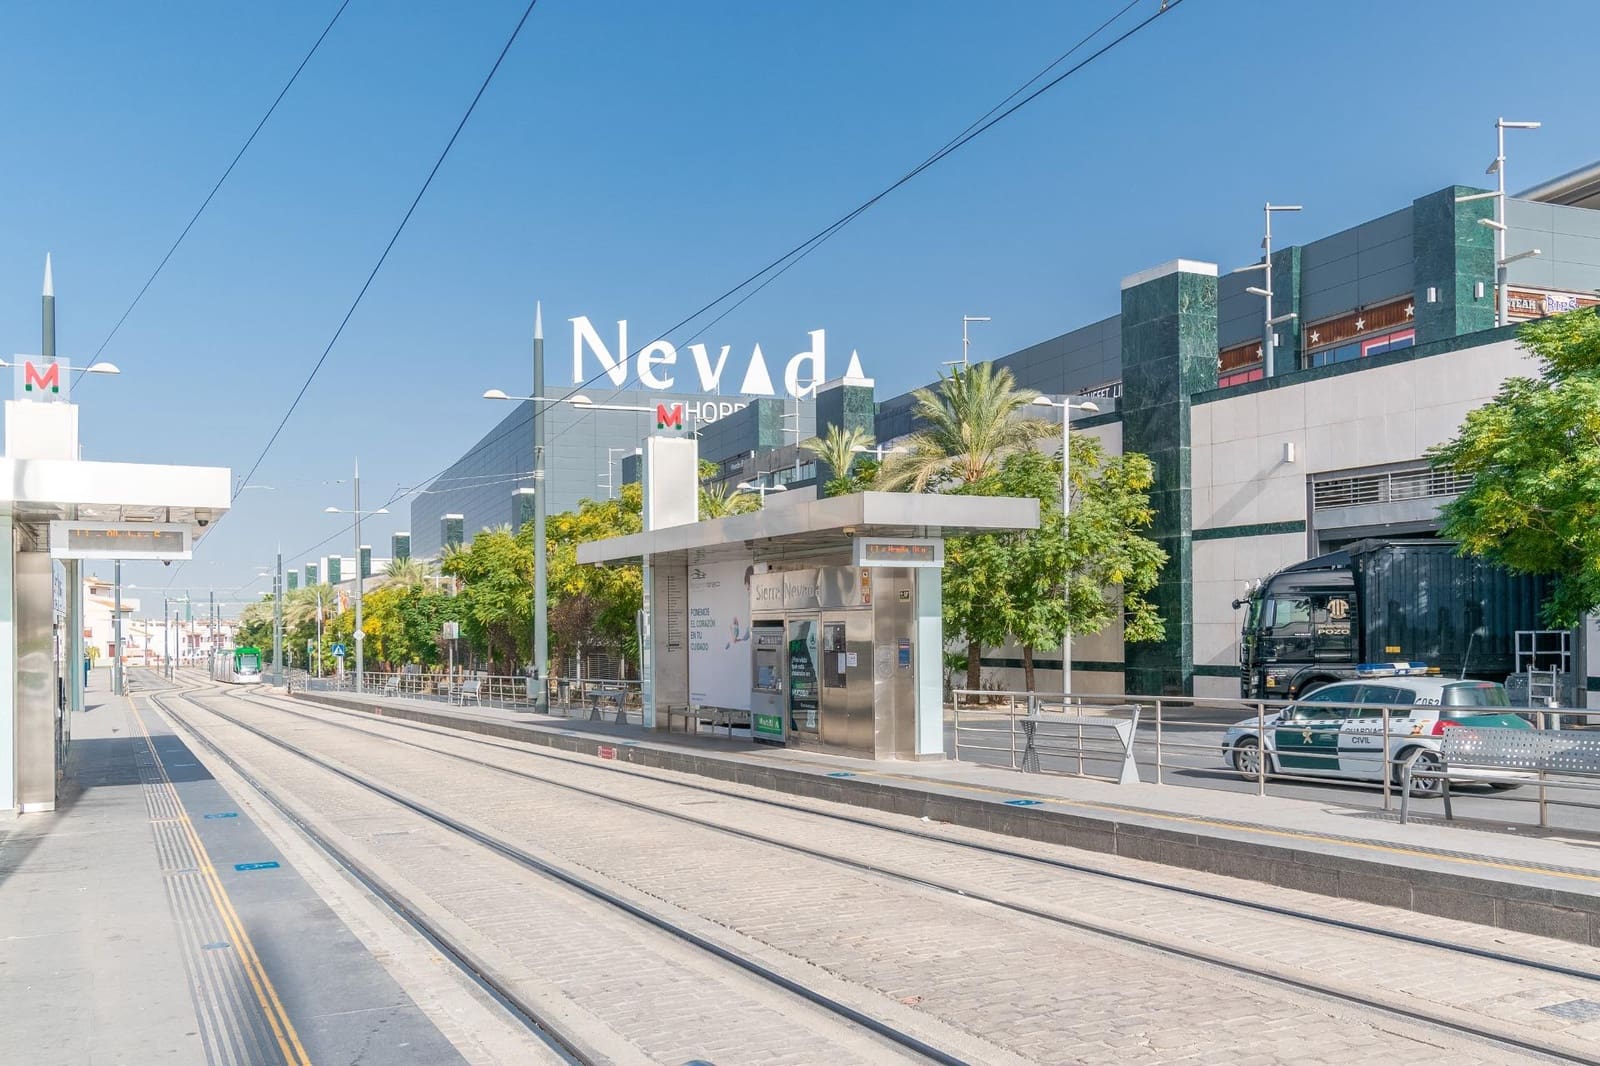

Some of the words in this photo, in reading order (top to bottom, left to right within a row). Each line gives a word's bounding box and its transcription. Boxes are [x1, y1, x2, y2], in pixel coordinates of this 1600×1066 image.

[25, 361, 59, 392] M
[656, 403, 683, 430] M
[671, 400, 747, 424] HOP
[1351, 736, 1371, 745] CIVIL
